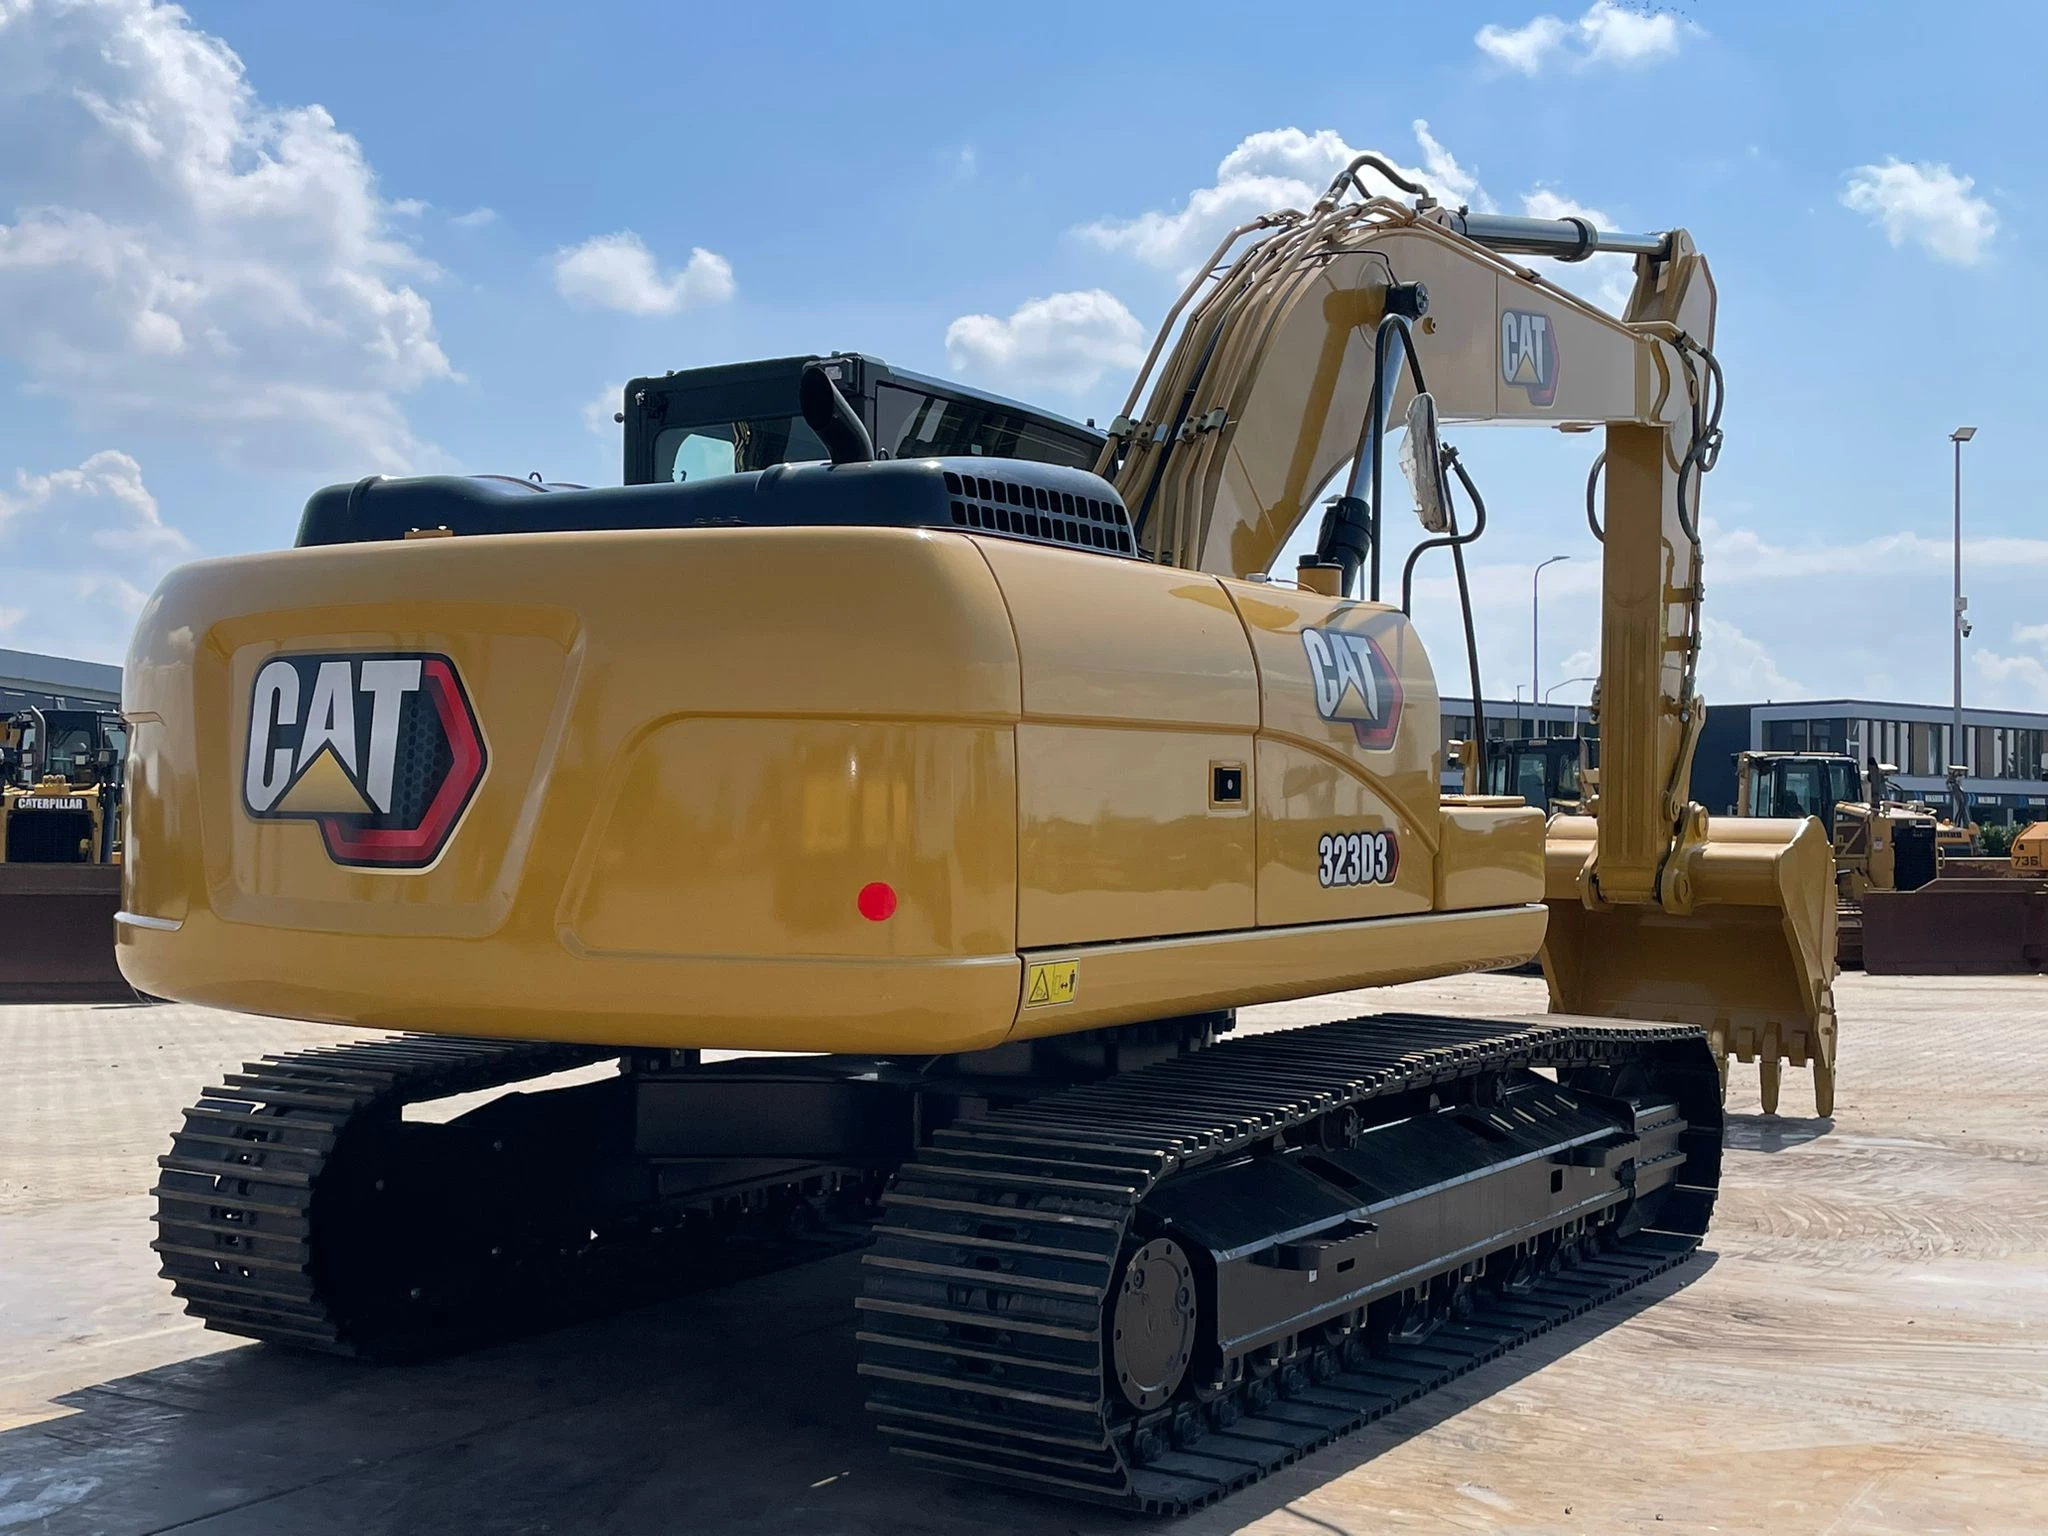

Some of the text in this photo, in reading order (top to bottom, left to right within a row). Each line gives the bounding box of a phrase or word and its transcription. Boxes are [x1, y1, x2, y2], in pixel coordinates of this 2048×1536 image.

[1502, 311, 1545, 384] CAT
[1302, 628, 1379, 721] CAT
[246, 660, 422, 814] CAT
[18, 798, 83, 809] CATERPILLAR
[1319, 833, 1388, 886] 323D3
